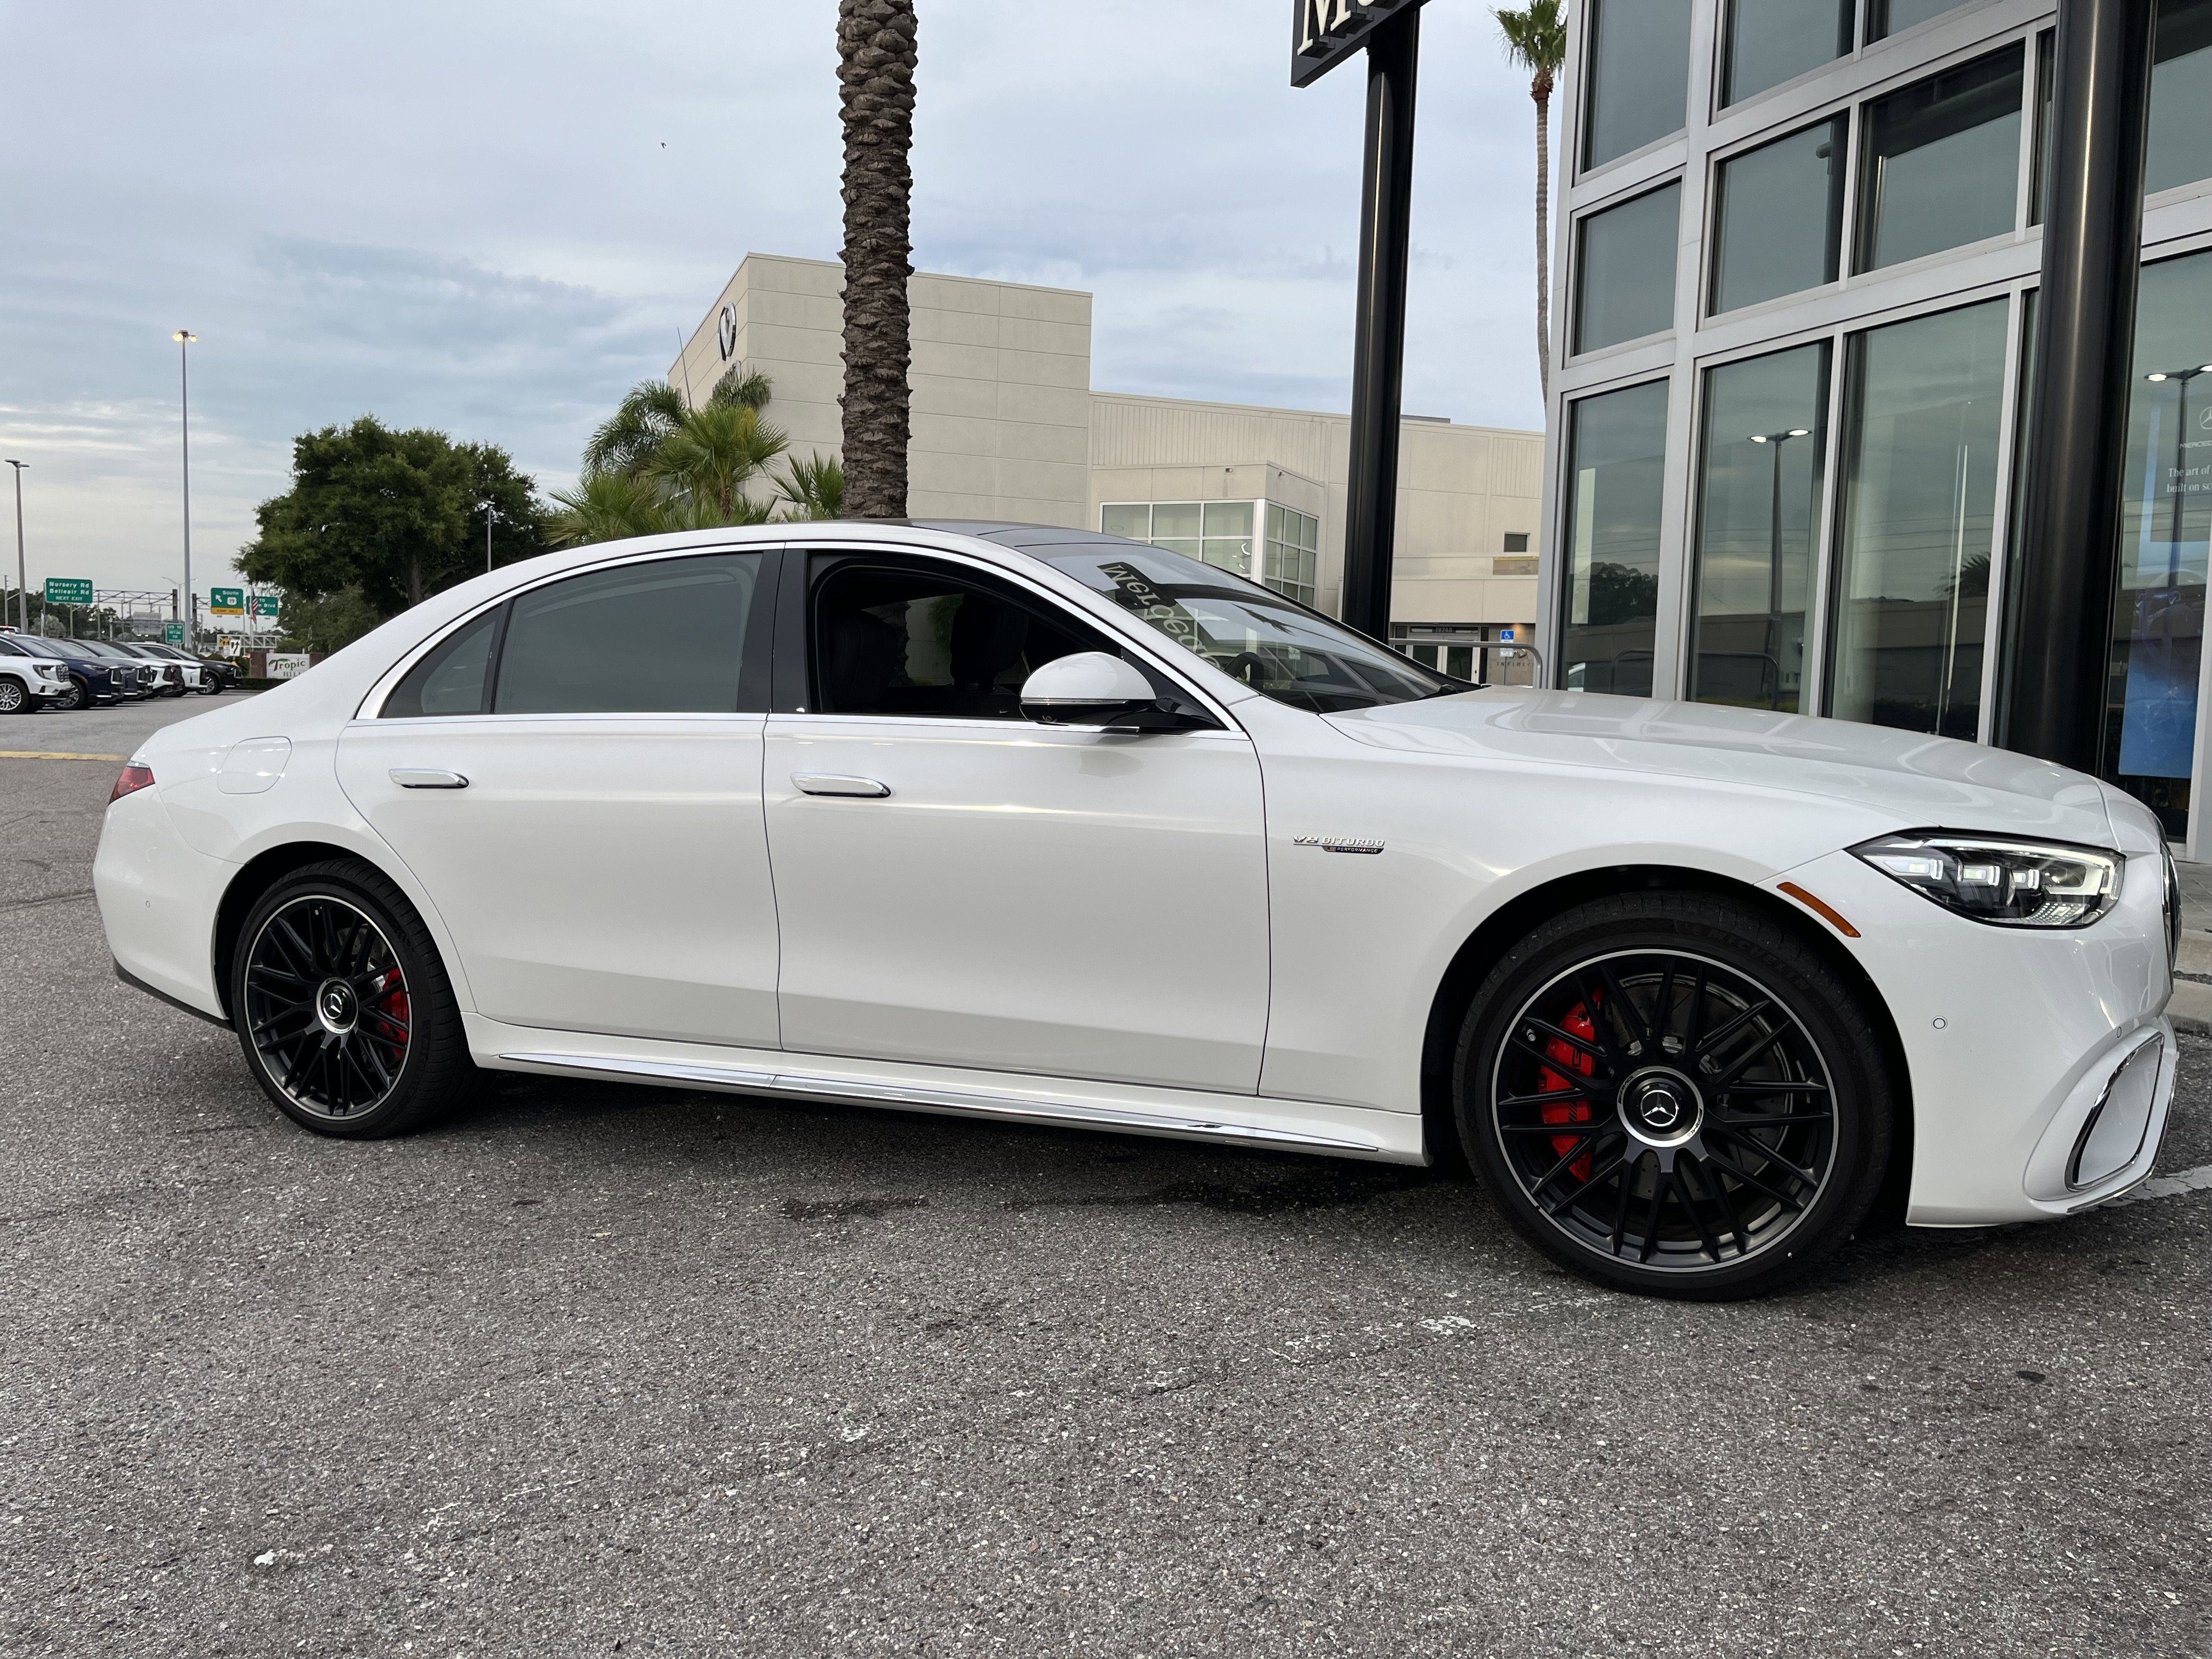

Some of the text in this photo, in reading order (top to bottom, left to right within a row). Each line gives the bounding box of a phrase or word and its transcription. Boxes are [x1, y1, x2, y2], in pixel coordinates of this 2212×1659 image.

[2168, 465, 2211, 477] The art of
[2167, 483, 2186, 493] built
[268, 658, 306, 672] Tropic
[1322, 837, 1385, 847] BITURBO
